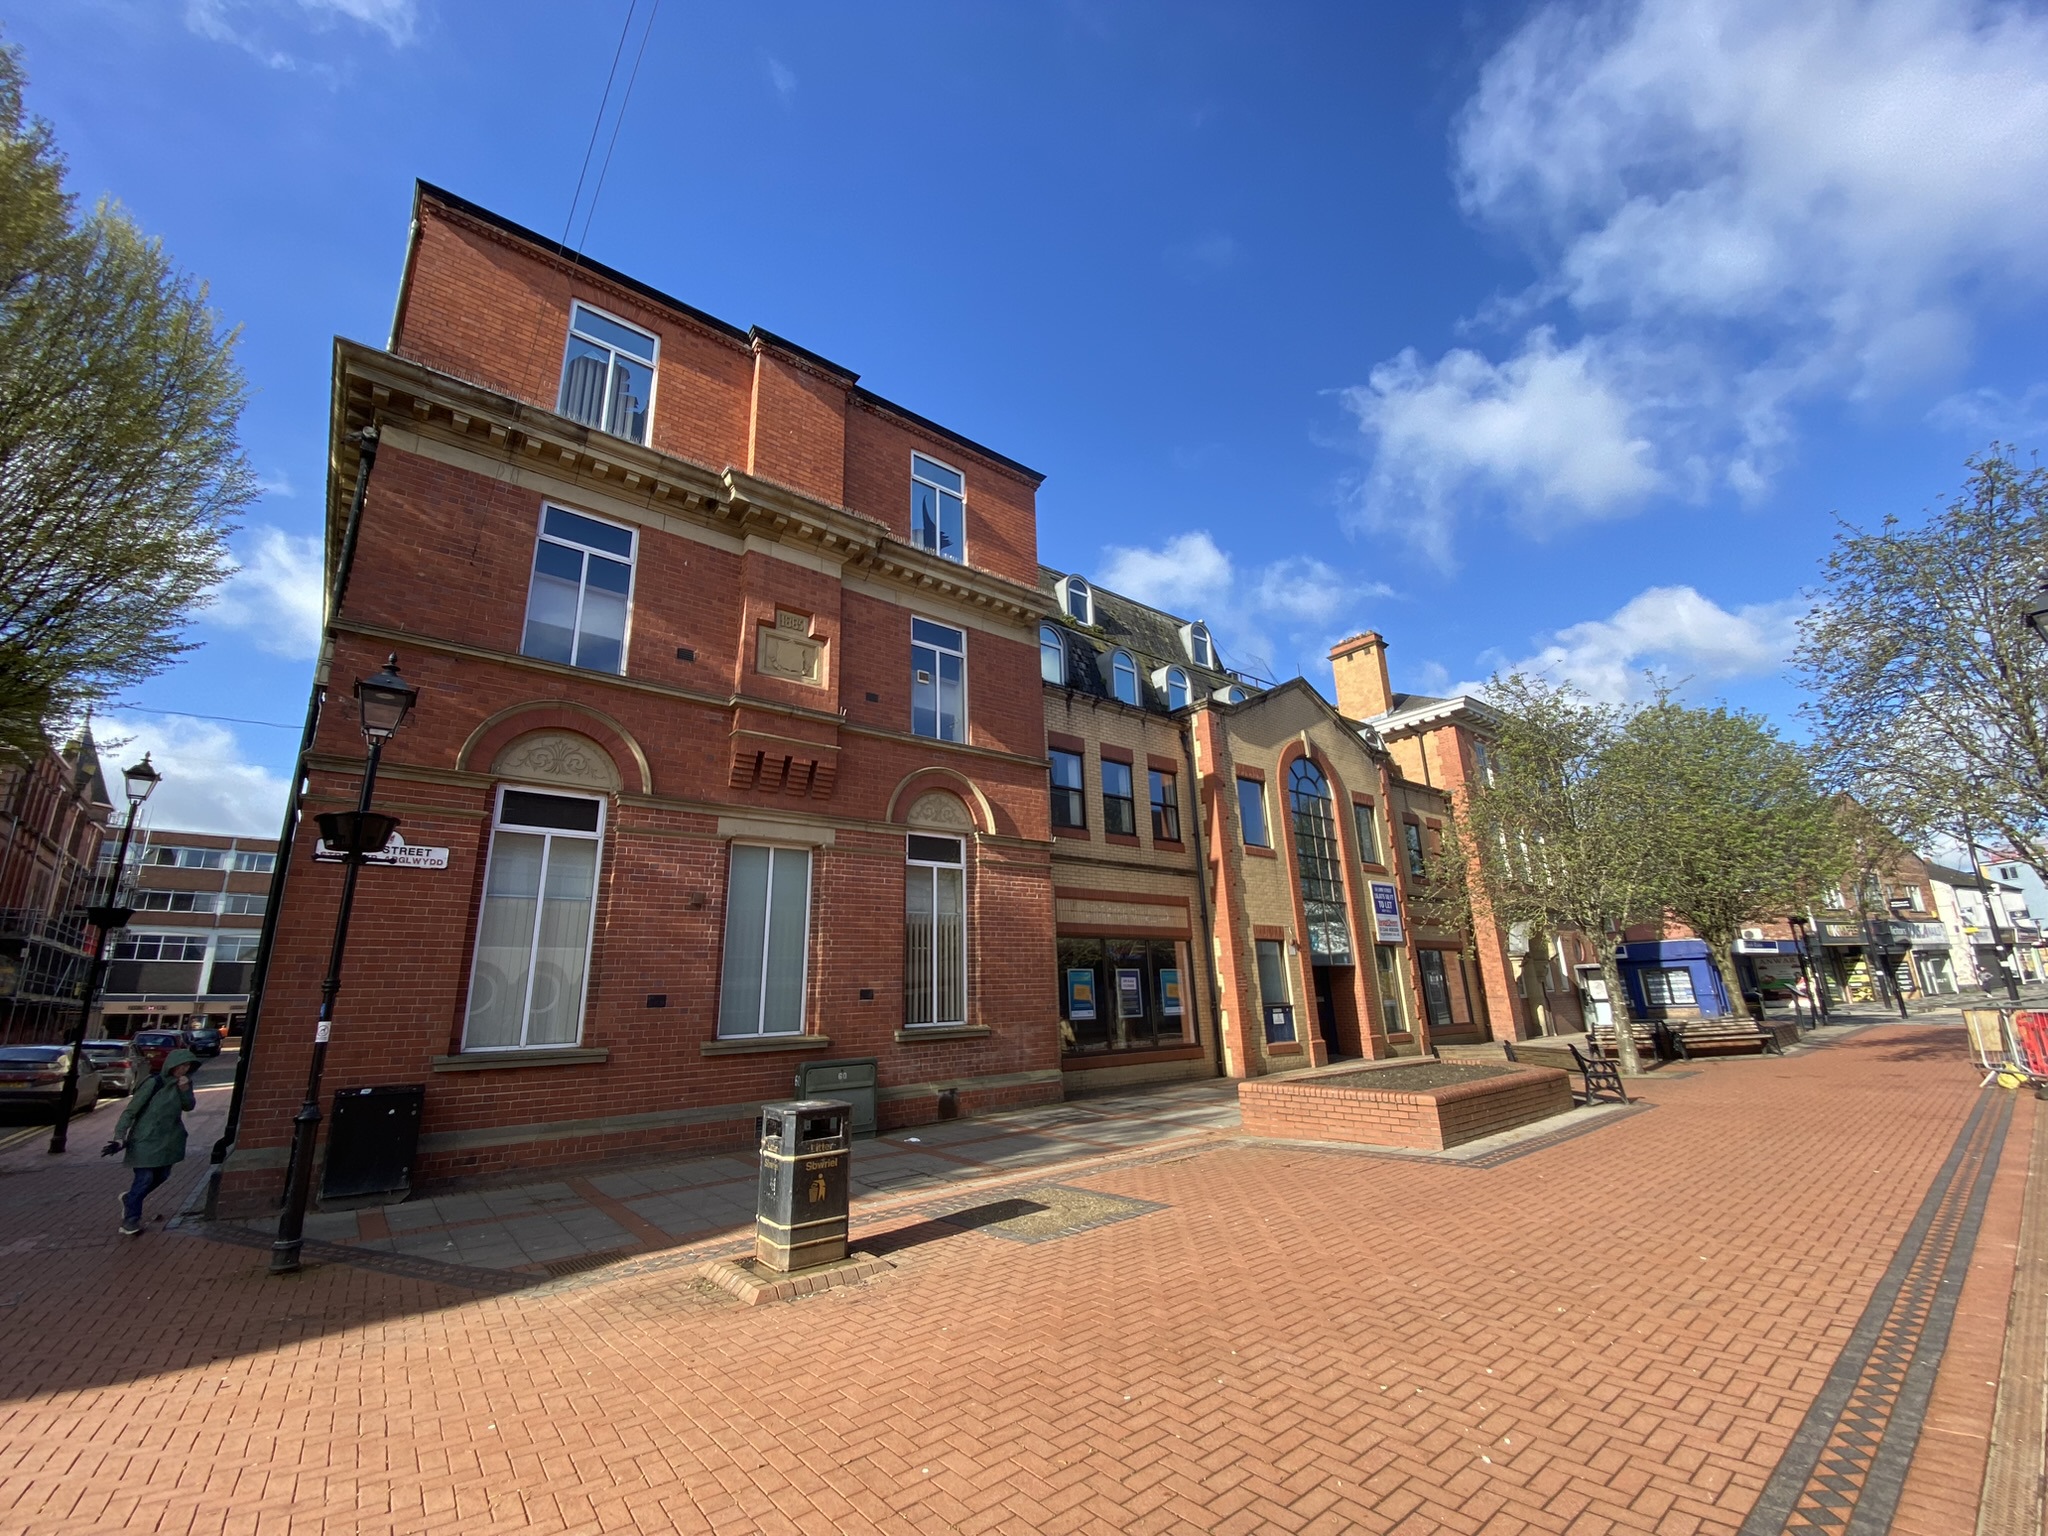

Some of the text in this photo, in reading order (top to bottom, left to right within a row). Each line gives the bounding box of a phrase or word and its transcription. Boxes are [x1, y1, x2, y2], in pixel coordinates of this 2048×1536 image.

[383, 846, 433, 857] STREET
[838, 1072, 848, 1080] 60
[811, 1143, 834, 1152] Litter
[805, 1158, 838, 1171] Sbwriel
